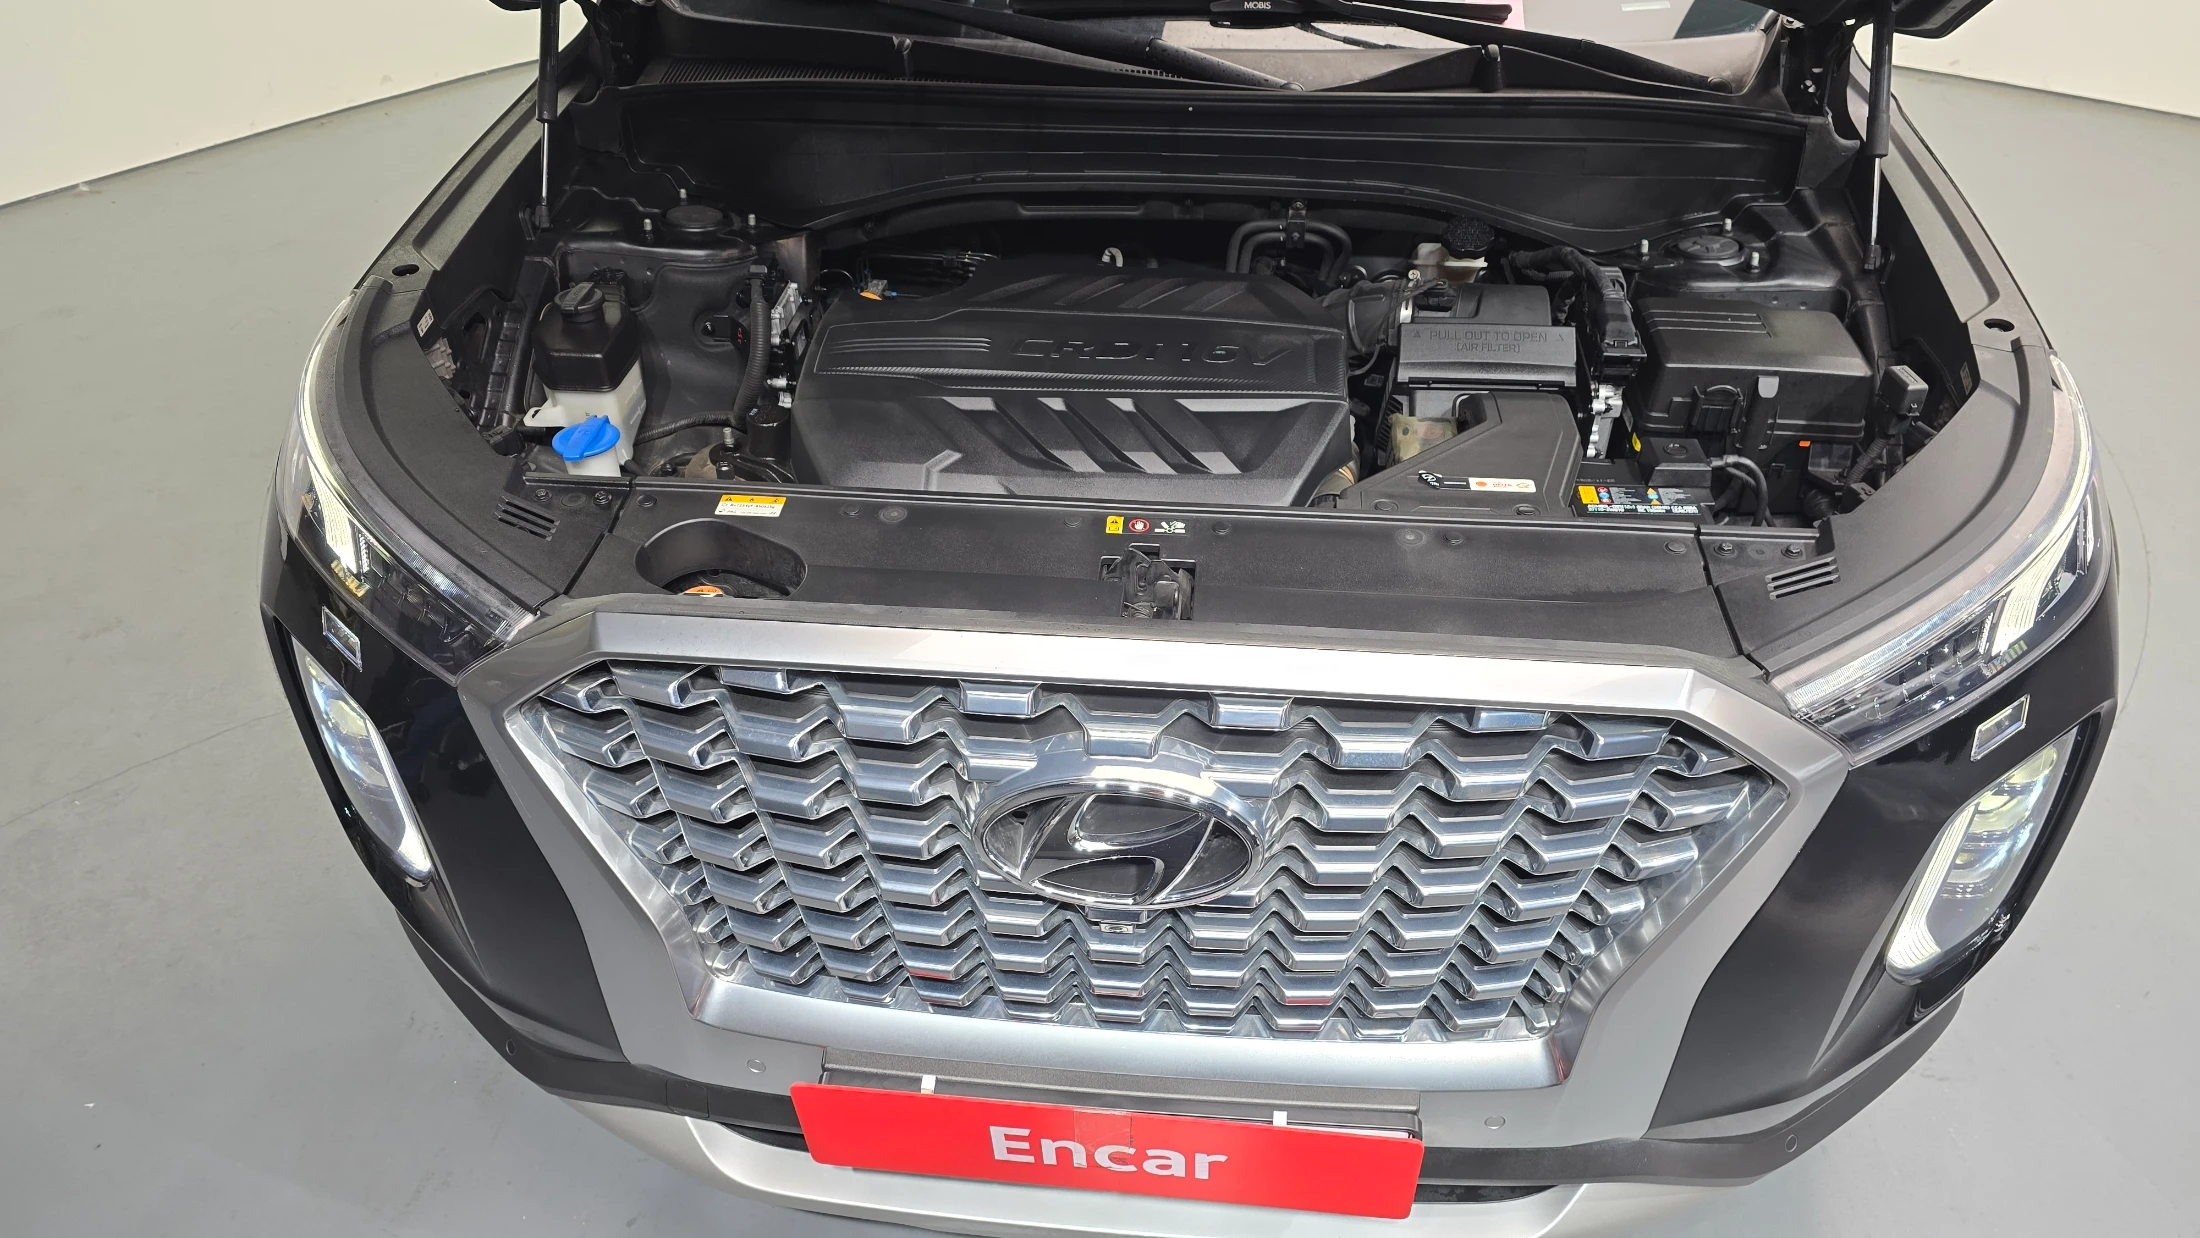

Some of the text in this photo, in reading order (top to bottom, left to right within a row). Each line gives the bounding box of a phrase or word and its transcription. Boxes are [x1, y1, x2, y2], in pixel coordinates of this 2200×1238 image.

[1244, 1, 1272, 9] MOBIS
[1429, 330, 1548, 342] PULL OUT TO OPEN
[1456, 342, 1521, 353] (AIR FILTER)
[989, 1125, 1229, 1180] Encar
